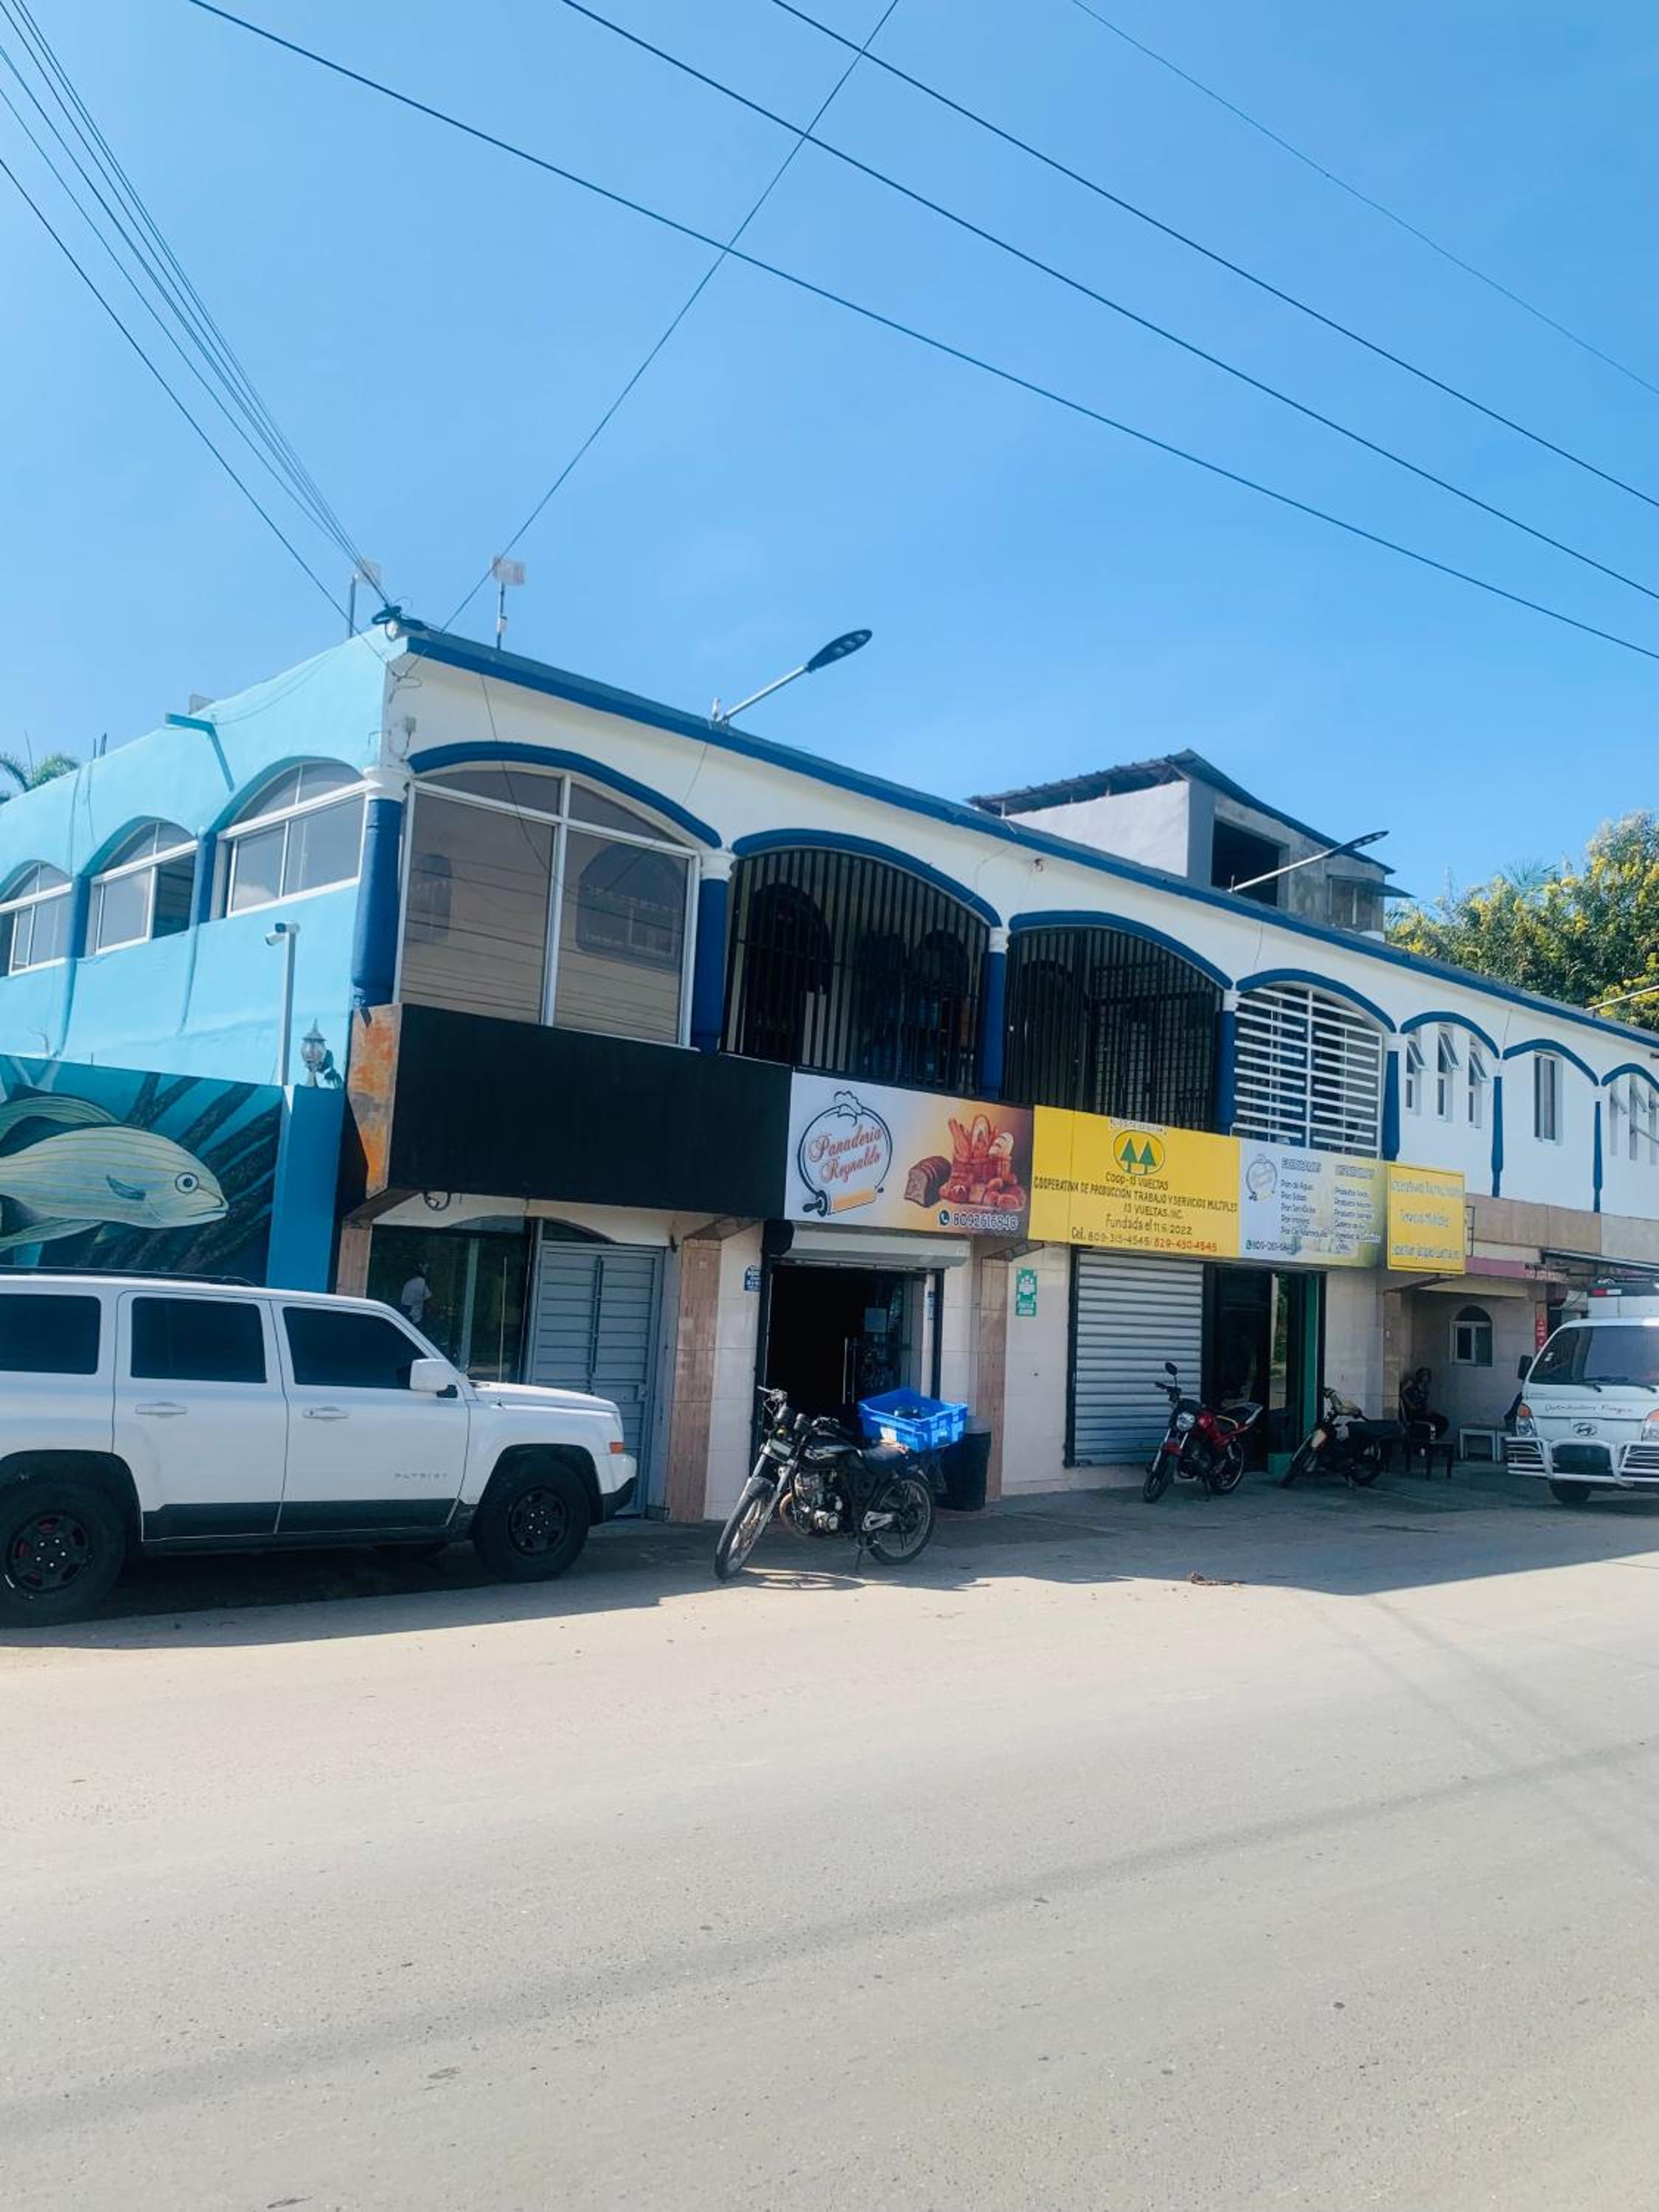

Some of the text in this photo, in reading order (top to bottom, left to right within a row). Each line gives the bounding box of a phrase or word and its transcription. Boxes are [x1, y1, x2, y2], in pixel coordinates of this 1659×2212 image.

[821, 1144, 880, 1183] Reynaldo
[1138, 1177, 1169, 1191] VUELTAS
[1133, 1191, 1167, 1204] TRABAJO
[1105, 1213, 1143, 1231] Fundada
